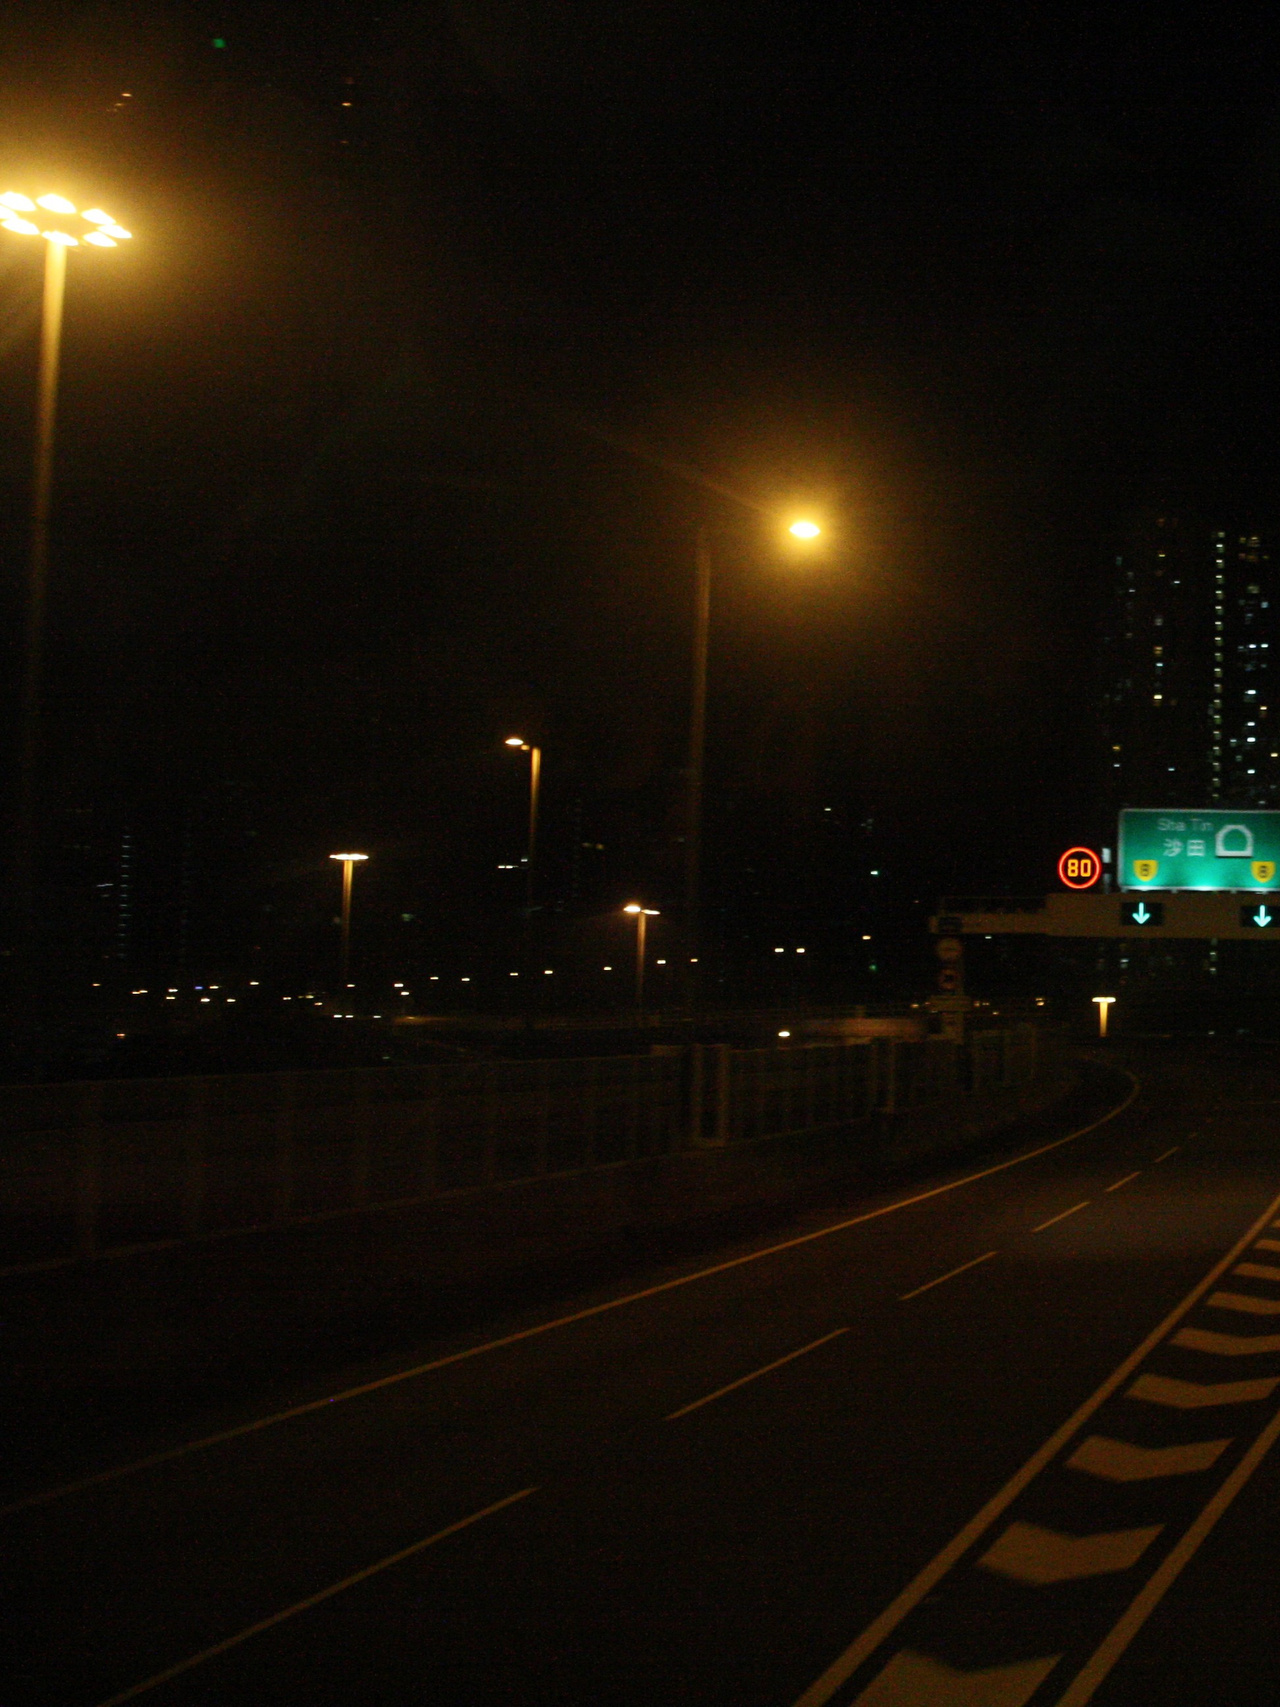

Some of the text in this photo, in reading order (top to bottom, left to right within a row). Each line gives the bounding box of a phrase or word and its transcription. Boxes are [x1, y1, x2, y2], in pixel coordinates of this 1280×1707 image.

[1157, 817, 1214, 832] Sha Tin
[1163, 838, 1206, 857] 沙田
[1067, 858, 1091, 878] 80
